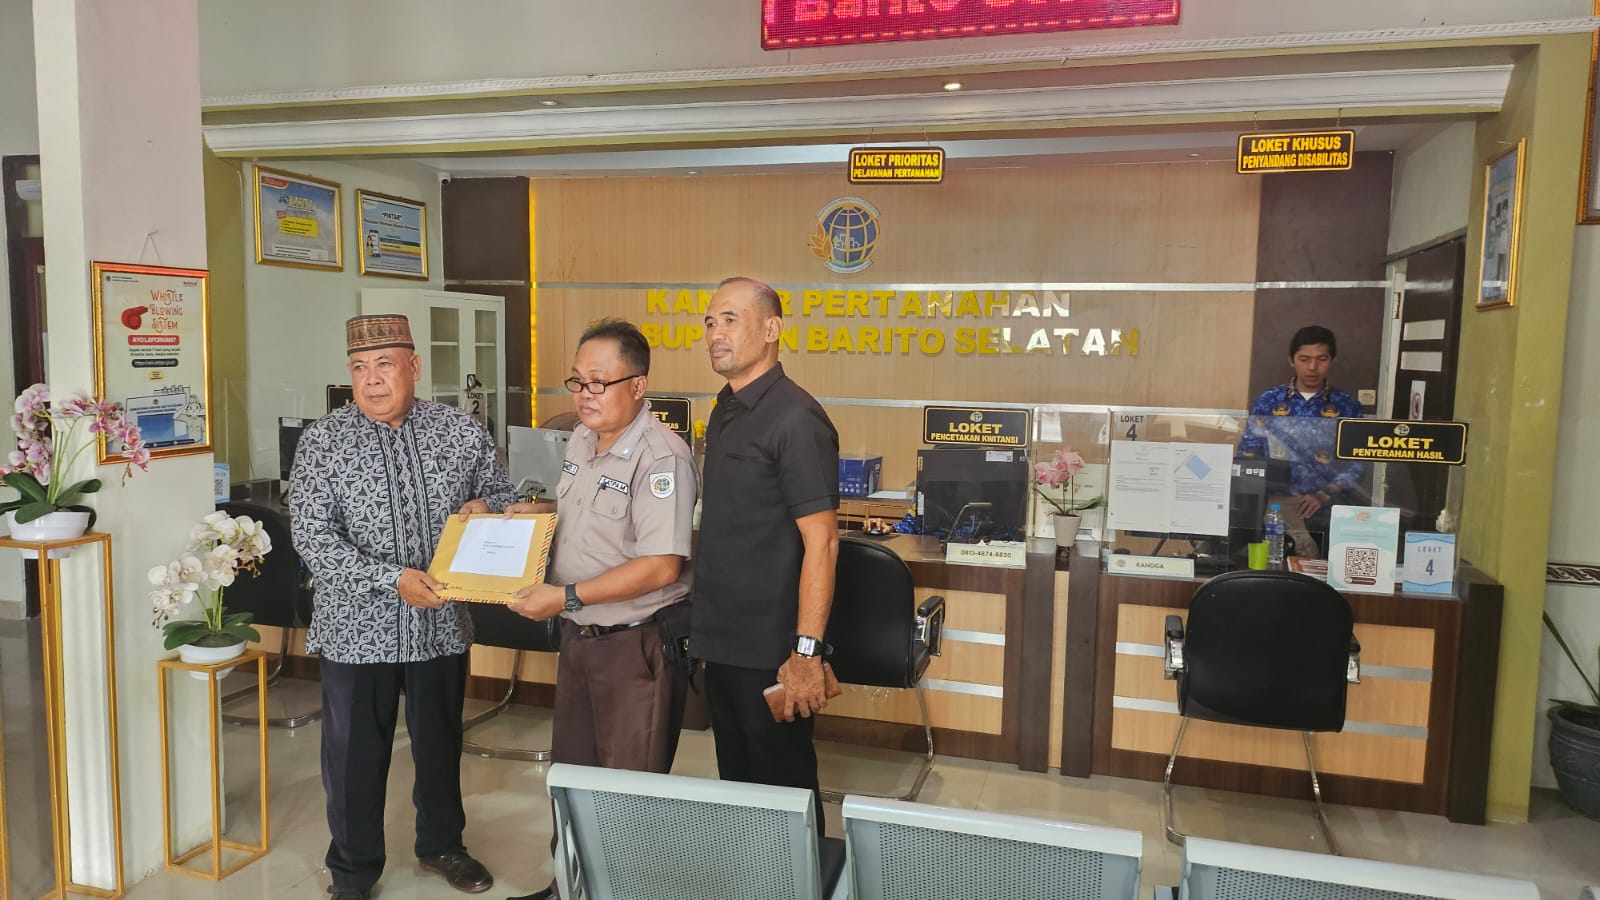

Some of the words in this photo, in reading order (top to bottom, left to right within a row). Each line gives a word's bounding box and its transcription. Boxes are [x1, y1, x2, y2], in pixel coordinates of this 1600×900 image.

[1251, 139, 1290, 152] LOKET
[1292, 137, 1341, 150] KHUSUS
[855, 154, 887, 166] LOKET
[888, 154, 939, 167] PRIORITAS
[1243, 154, 1297, 168] PENYANDANG
[1298, 152, 1348, 166] DISABILITAS
[854, 168, 893, 177] PELAYANAN
[894, 168, 940, 177] PERTANAHAN
[647, 289, 793, 316] KANR
[802, 290, 1070, 318] PERTANAHAN
[807, 326, 946, 353] BARITO
[954, 327, 1139, 356] SELATAN
[472, 400, 480, 414] 2
[949, 422, 1003, 434] LOKET
[1126, 424, 1137, 440] 4
[931, 433, 980, 442] PENCETAKAN
[982, 435, 1018, 444] KWITANSI
[1367, 436, 1434, 449] LOKET
[1353, 448, 1414, 458] PENYERAHAN
[1416, 451, 1444, 460] HASIL
[1425, 559, 1434, 576] 4
